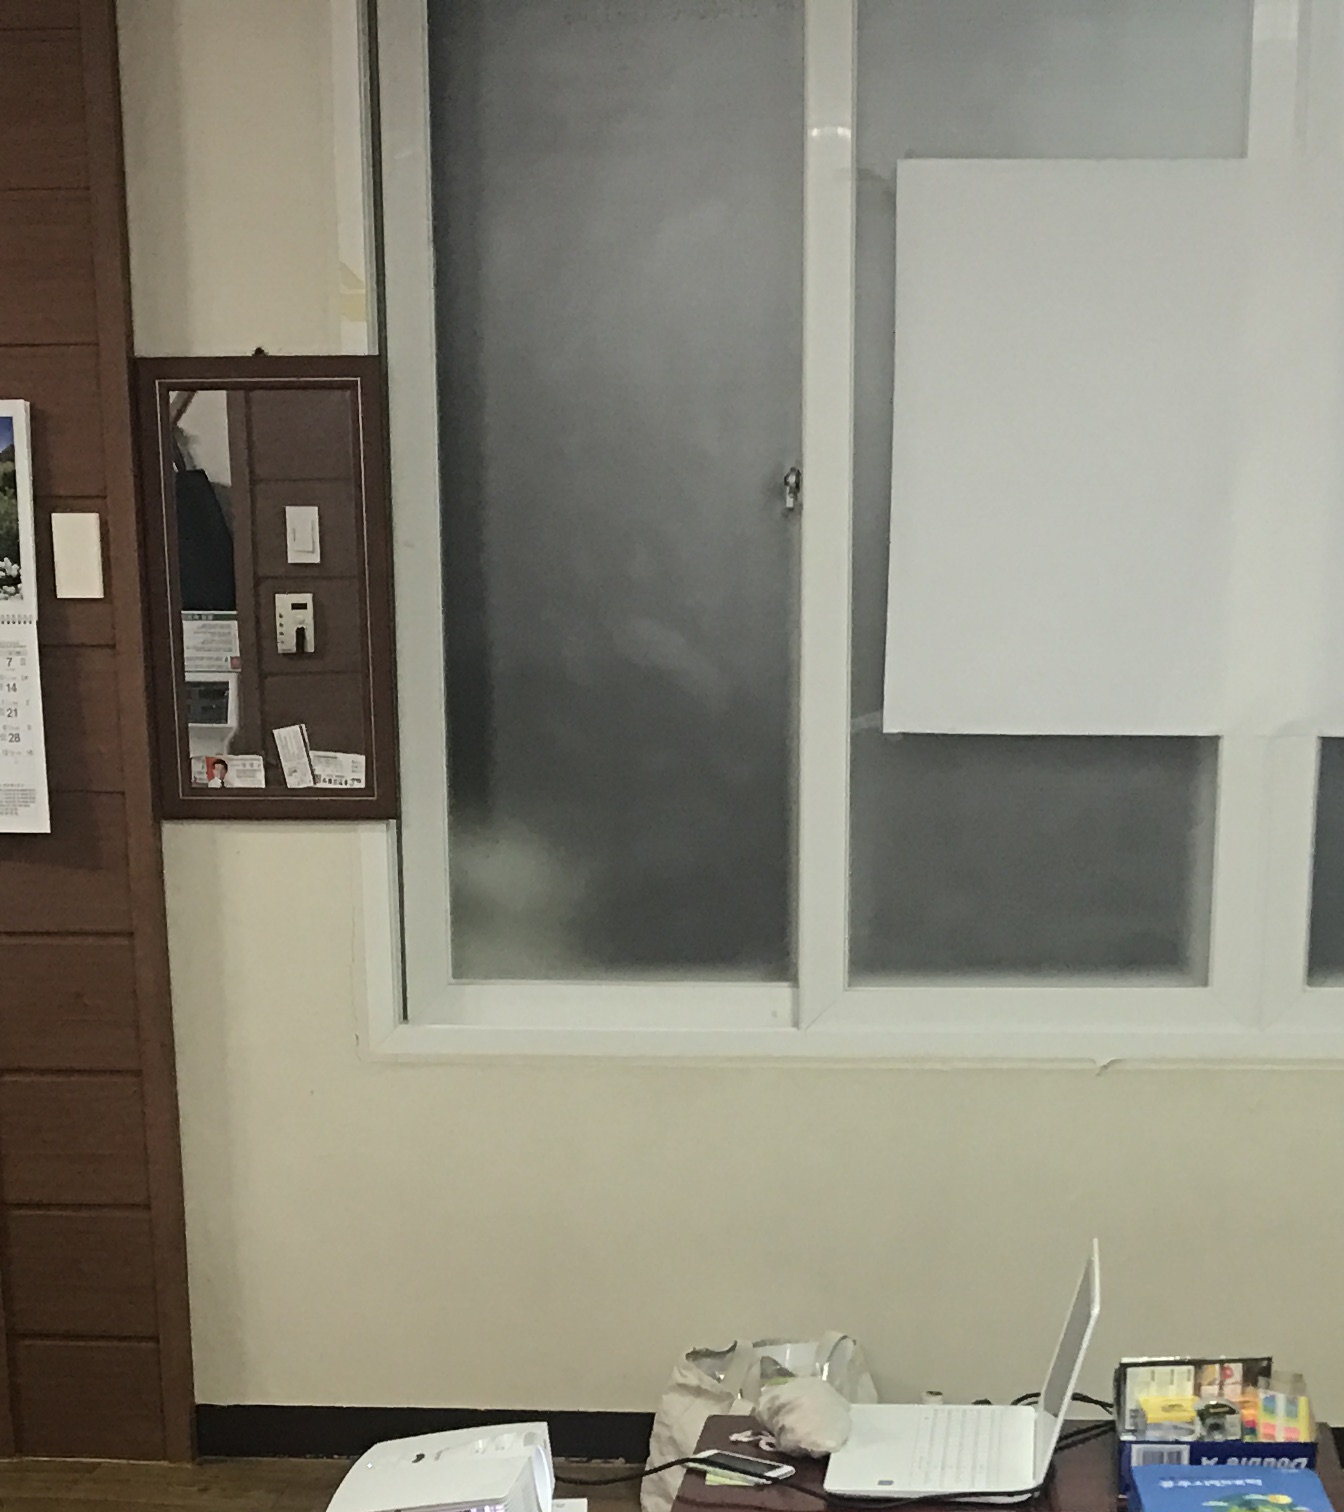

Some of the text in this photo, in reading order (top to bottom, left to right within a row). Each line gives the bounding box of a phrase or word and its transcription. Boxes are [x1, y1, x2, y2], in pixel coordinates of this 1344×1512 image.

[6, 657, 12, 667] 7
[6, 683, 17, 692] 14
[7, 708, 17, 718] 21
[9, 733, 20, 743] 28
